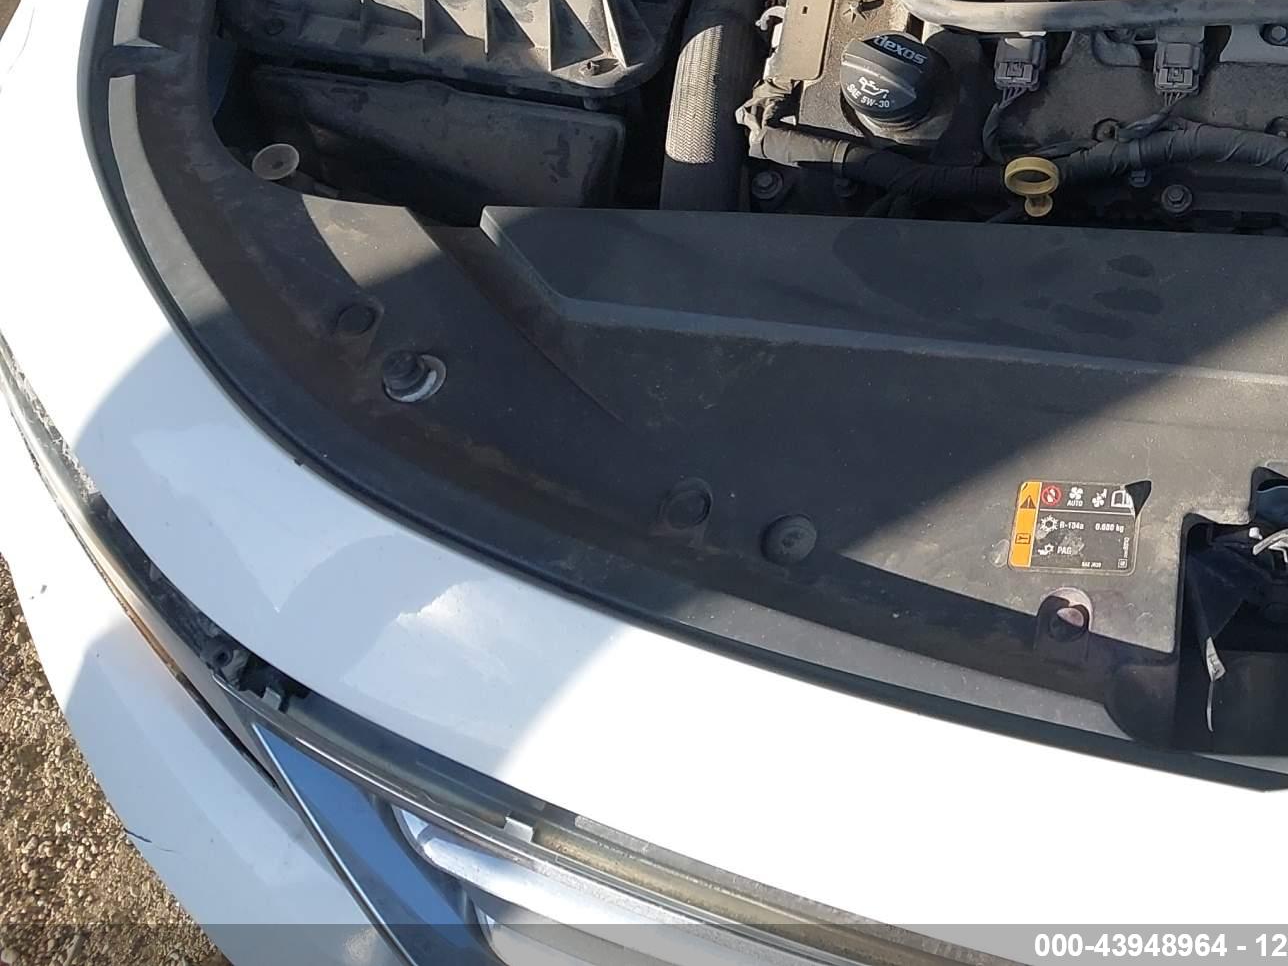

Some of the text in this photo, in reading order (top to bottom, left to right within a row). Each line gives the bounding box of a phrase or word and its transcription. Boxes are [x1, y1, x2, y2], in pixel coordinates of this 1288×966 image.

[873, 35, 928, 65] dexos
[846, 83, 890, 109] SAE 5W-30
[1057, 546, 1072, 555] PAG
